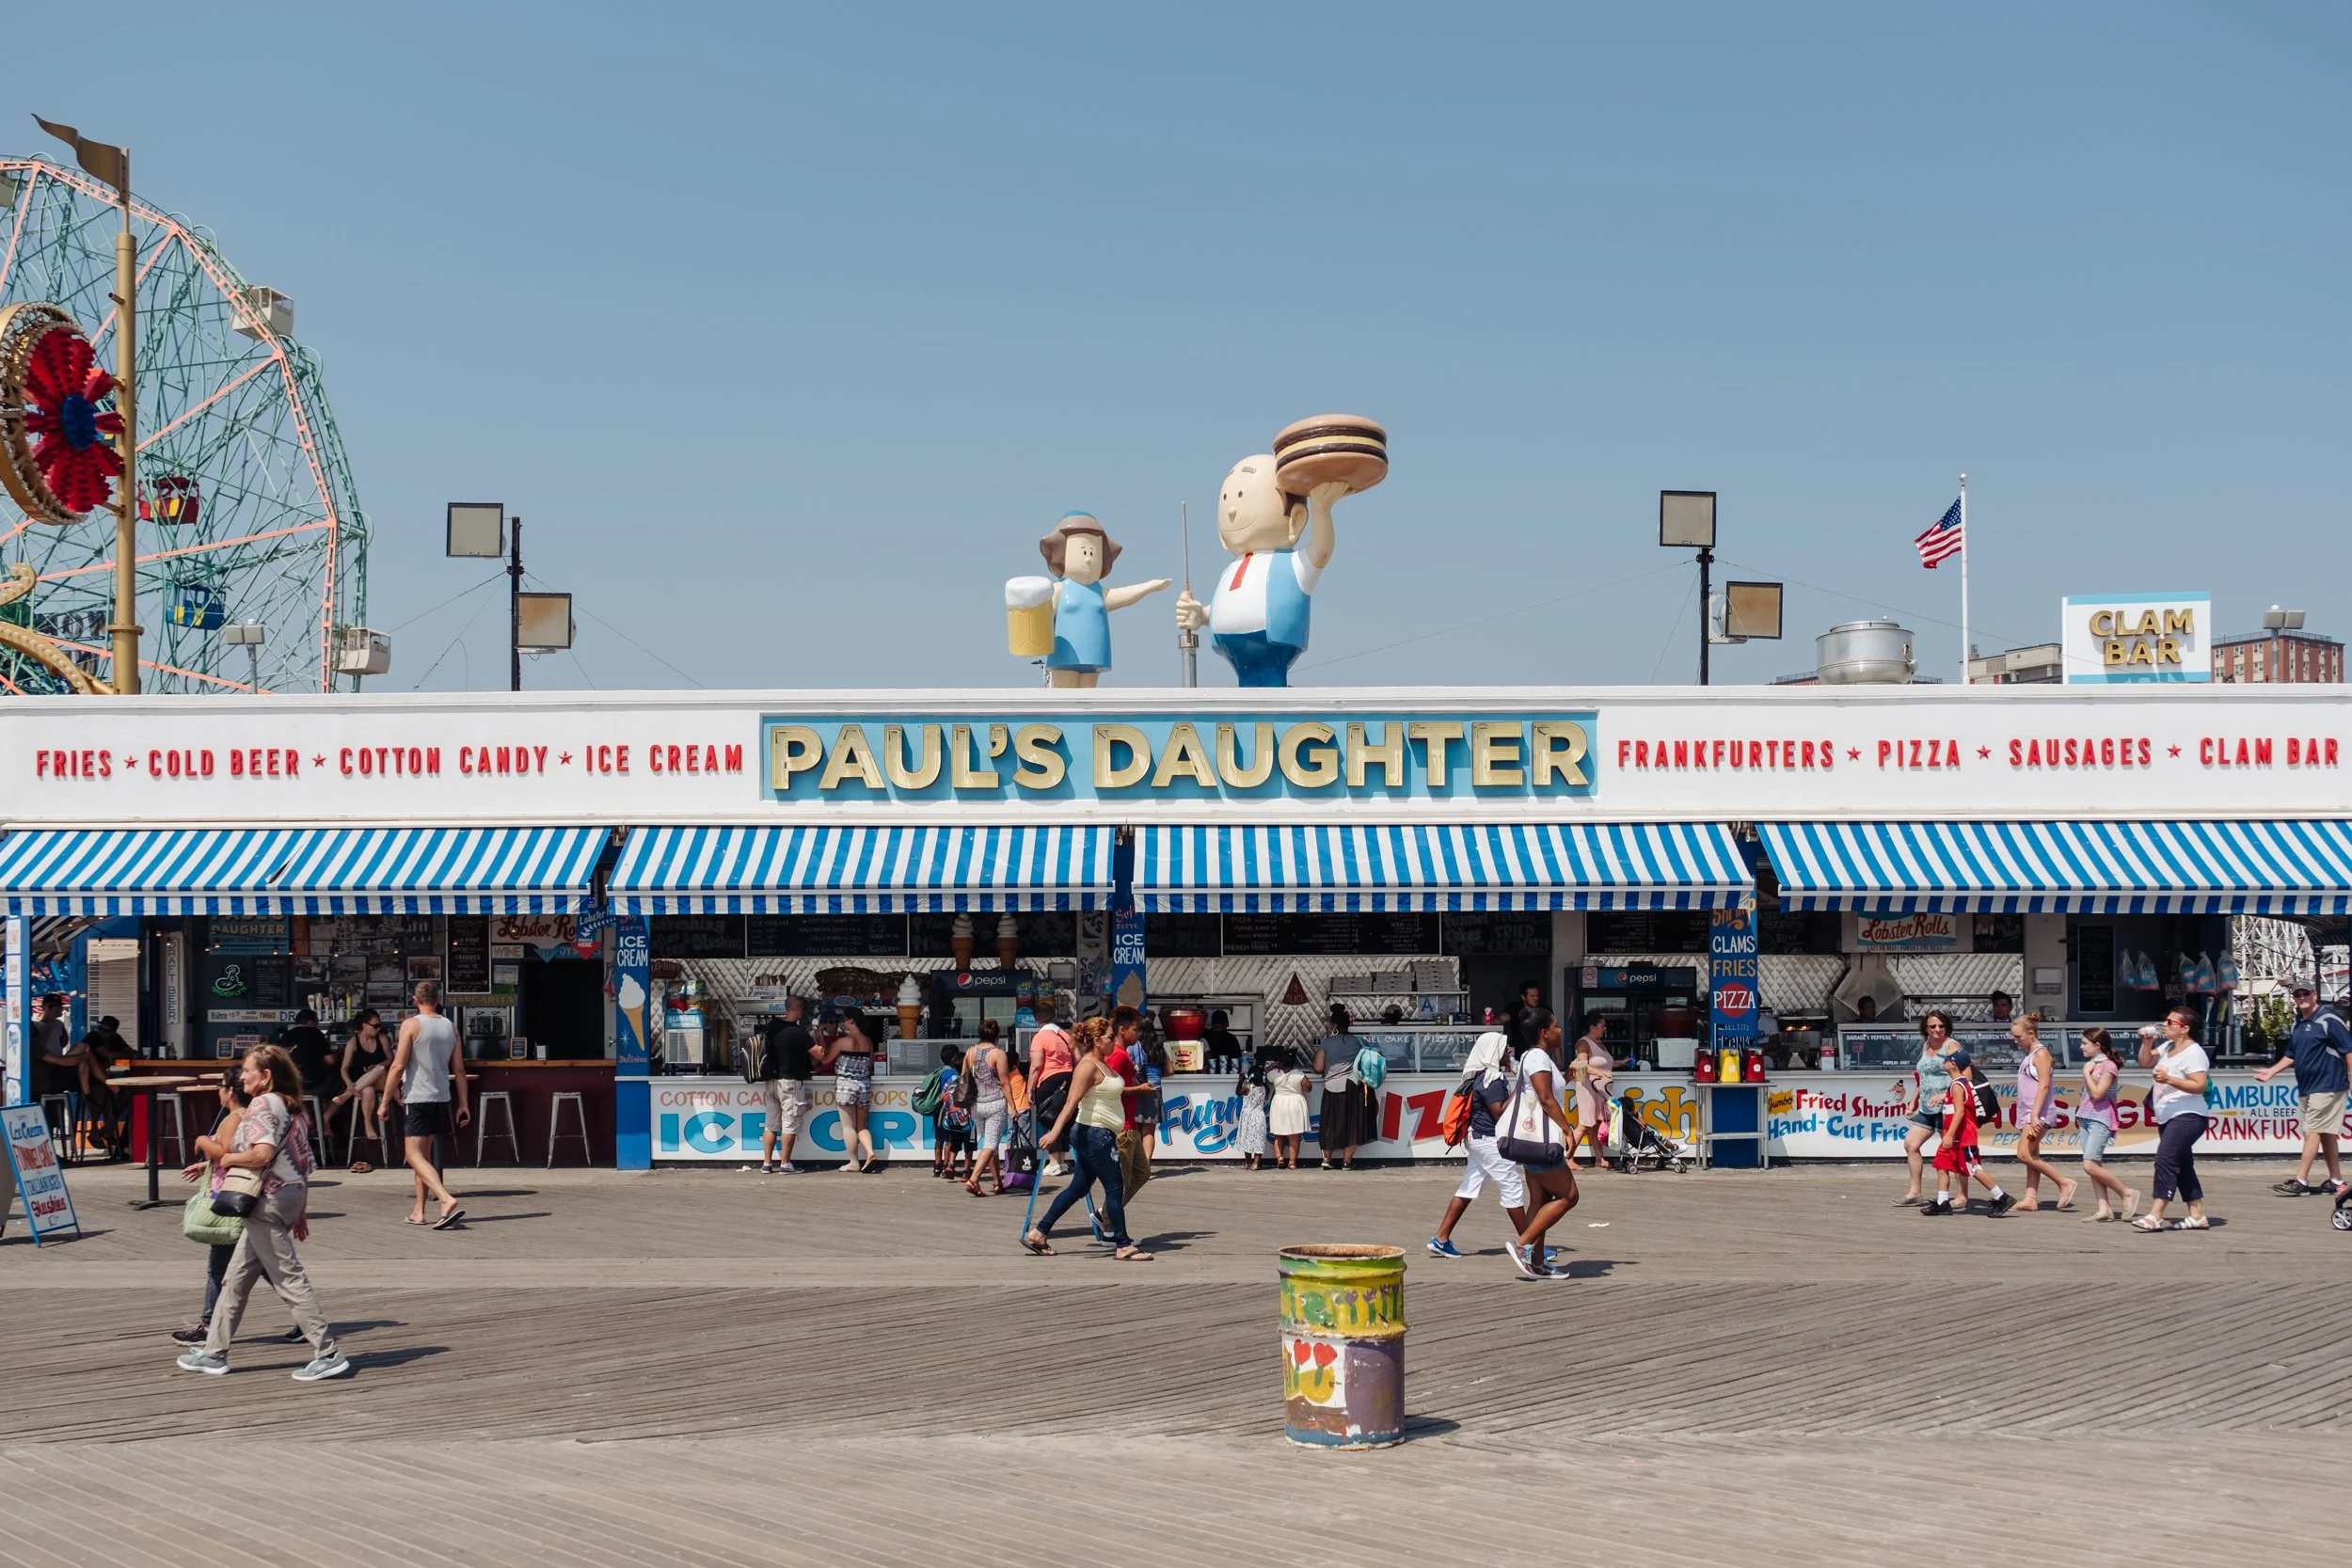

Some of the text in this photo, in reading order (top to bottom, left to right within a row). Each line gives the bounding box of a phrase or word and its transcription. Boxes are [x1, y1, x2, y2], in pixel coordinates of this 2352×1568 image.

[2089, 608, 2194, 637] CLAM
[2103, 638, 2183, 666] BAR
[339, 745, 548, 775] COTTON CANDY
[586, 744, 743, 773] ICE CREAM
[771, 721, 1590, 789] PAUL'S DAUGHTER
[1617, 739, 1834, 768] FRANKFURTERS
[1877, 738, 1961, 768] PIZZA
[2009, 736, 2152, 767] SAUSAGES
[2199, 736, 2339, 766] CLAM BAR
[37, 749, 112, 777] FRIES
[148, 748, 299, 777] COLD BEER
[497, 914, 552, 940] Lobster
[580, 910, 606, 926] Lobster
[1862, 912, 1952, 943] Lobster Rolls
[212, 925, 285, 935] DAUGHTER
[1116, 934, 1144, 946] ICE
[493, 946, 523, 958] WINE
[619, 935, 646, 948] ICE
[1712, 935, 1756, 953] CLAMS
[617, 949, 648, 967] CREAM
[1113, 947, 1145, 964] CREAM
[1712, 958, 1756, 977] FRIES
[167, 941, 176, 1021] DRAFT BEER
[974, 974, 1006, 987] pepsi
[1080, 974, 1094, 986] IC
[1629, 973, 1657, 984] pepsi
[447, 996, 515, 1005] MARGARITA
[1421, 997, 1434, 1013] A
[1712, 990, 1756, 1009] PIZZA
[660, 1090, 731, 1107] COTTON
[1769, 1095, 1794, 1113] Jumbo
[1796, 1088, 1847, 1113] Fried
[2249, 1107, 2296, 1117] ALL BEEF
[660, 1111, 783, 1154] ICE
[1870, 1122, 1910, 1143] Frie
[24, 1173, 62, 1197] ITALIAN ICES
[30, 1195, 68, 1218] Slushies
